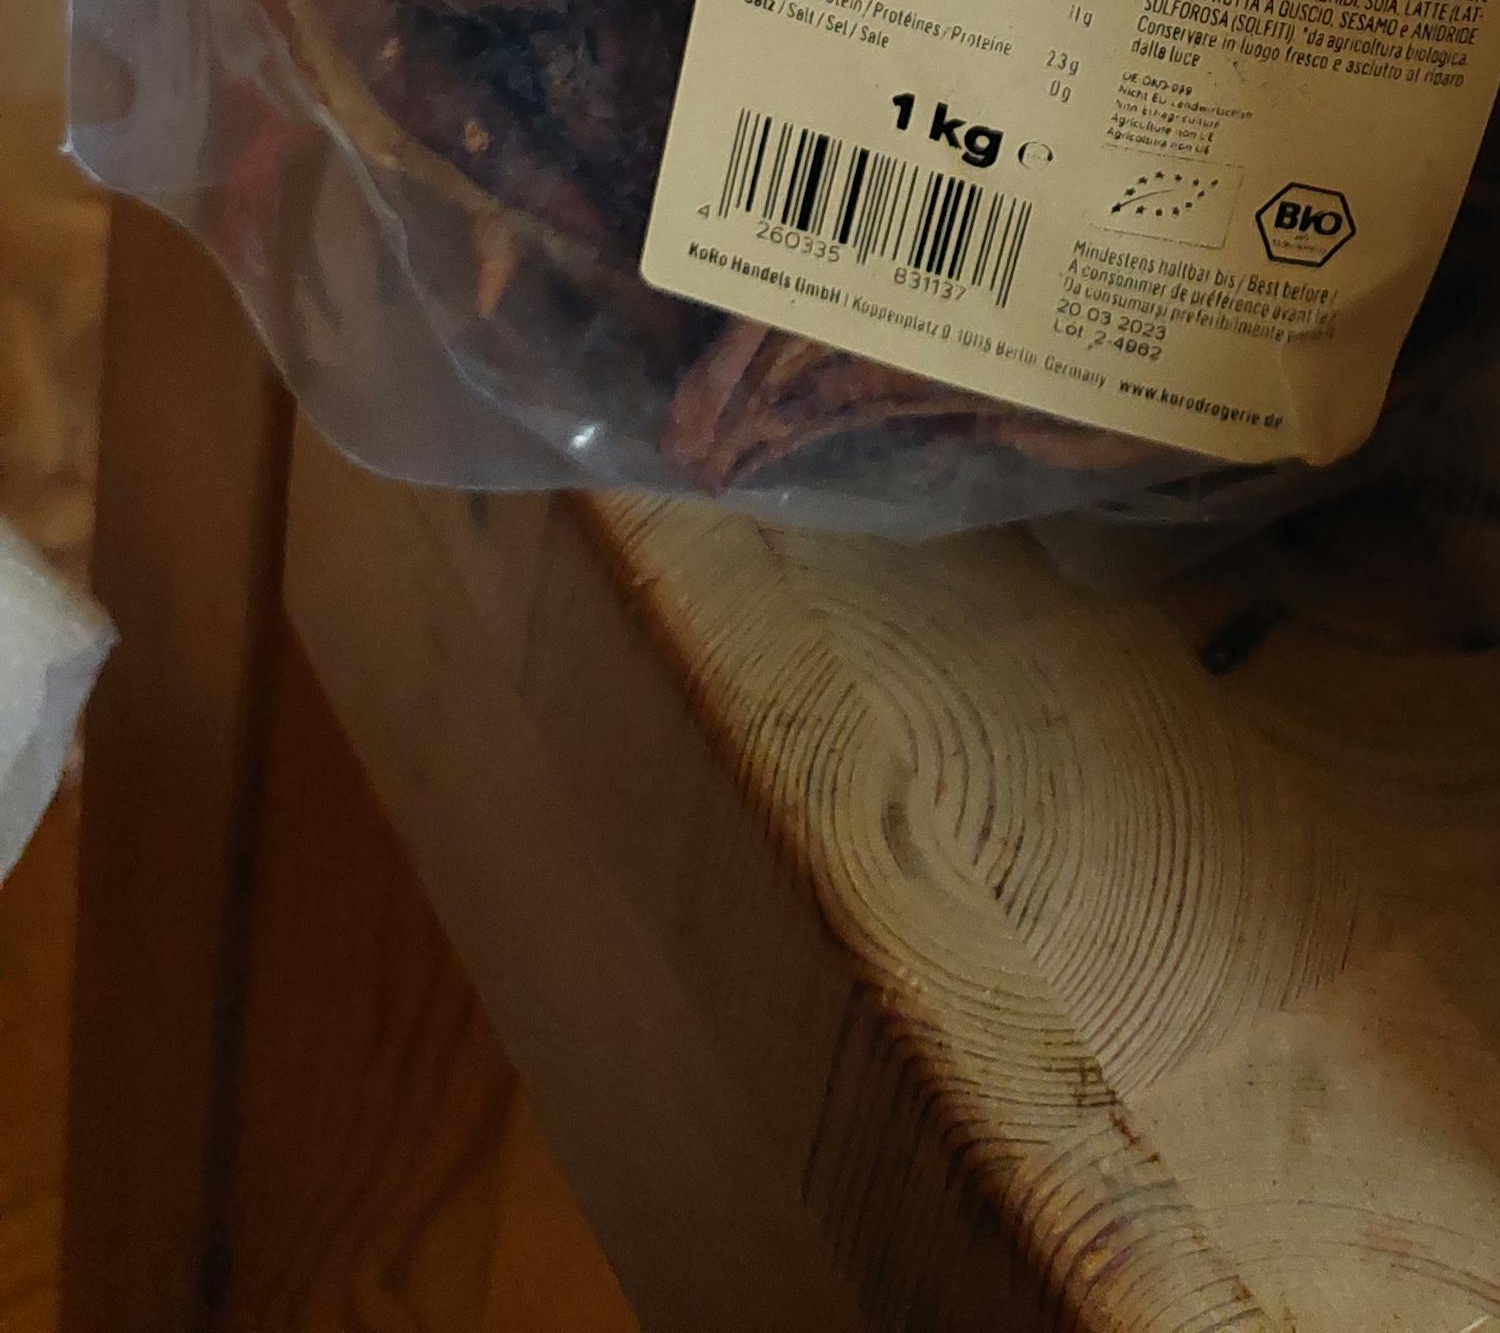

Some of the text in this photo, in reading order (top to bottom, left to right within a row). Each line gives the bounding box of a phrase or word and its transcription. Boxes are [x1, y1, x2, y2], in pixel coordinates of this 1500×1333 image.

[1337, 11, 1399, 36] SESAMO
[1411, 23, 1479, 45] ANIDRIDE
[1403, 0, 1449, 19] LATTE
[1136, 15, 1218, 48] Conservare
[1238, 37, 1282, 63] luogo
[1284, 46, 1330, 69] fresco
[1168, 46, 1201, 67] luce
[1325, 31, 1404, 62] agricoltura
[893, 94, 1003, 168] 1 kg
[696, 202, 712, 220] 4
[1273, 199, 1345, 237] BIO
[754, 220, 844, 264] 260335
[892, 267, 968, 303] 831137
[1072, 240, 1156, 273] Mindestens
[1246, 276, 1281, 296] Best
[1056, 297, 1168, 341] 20 03 2023
